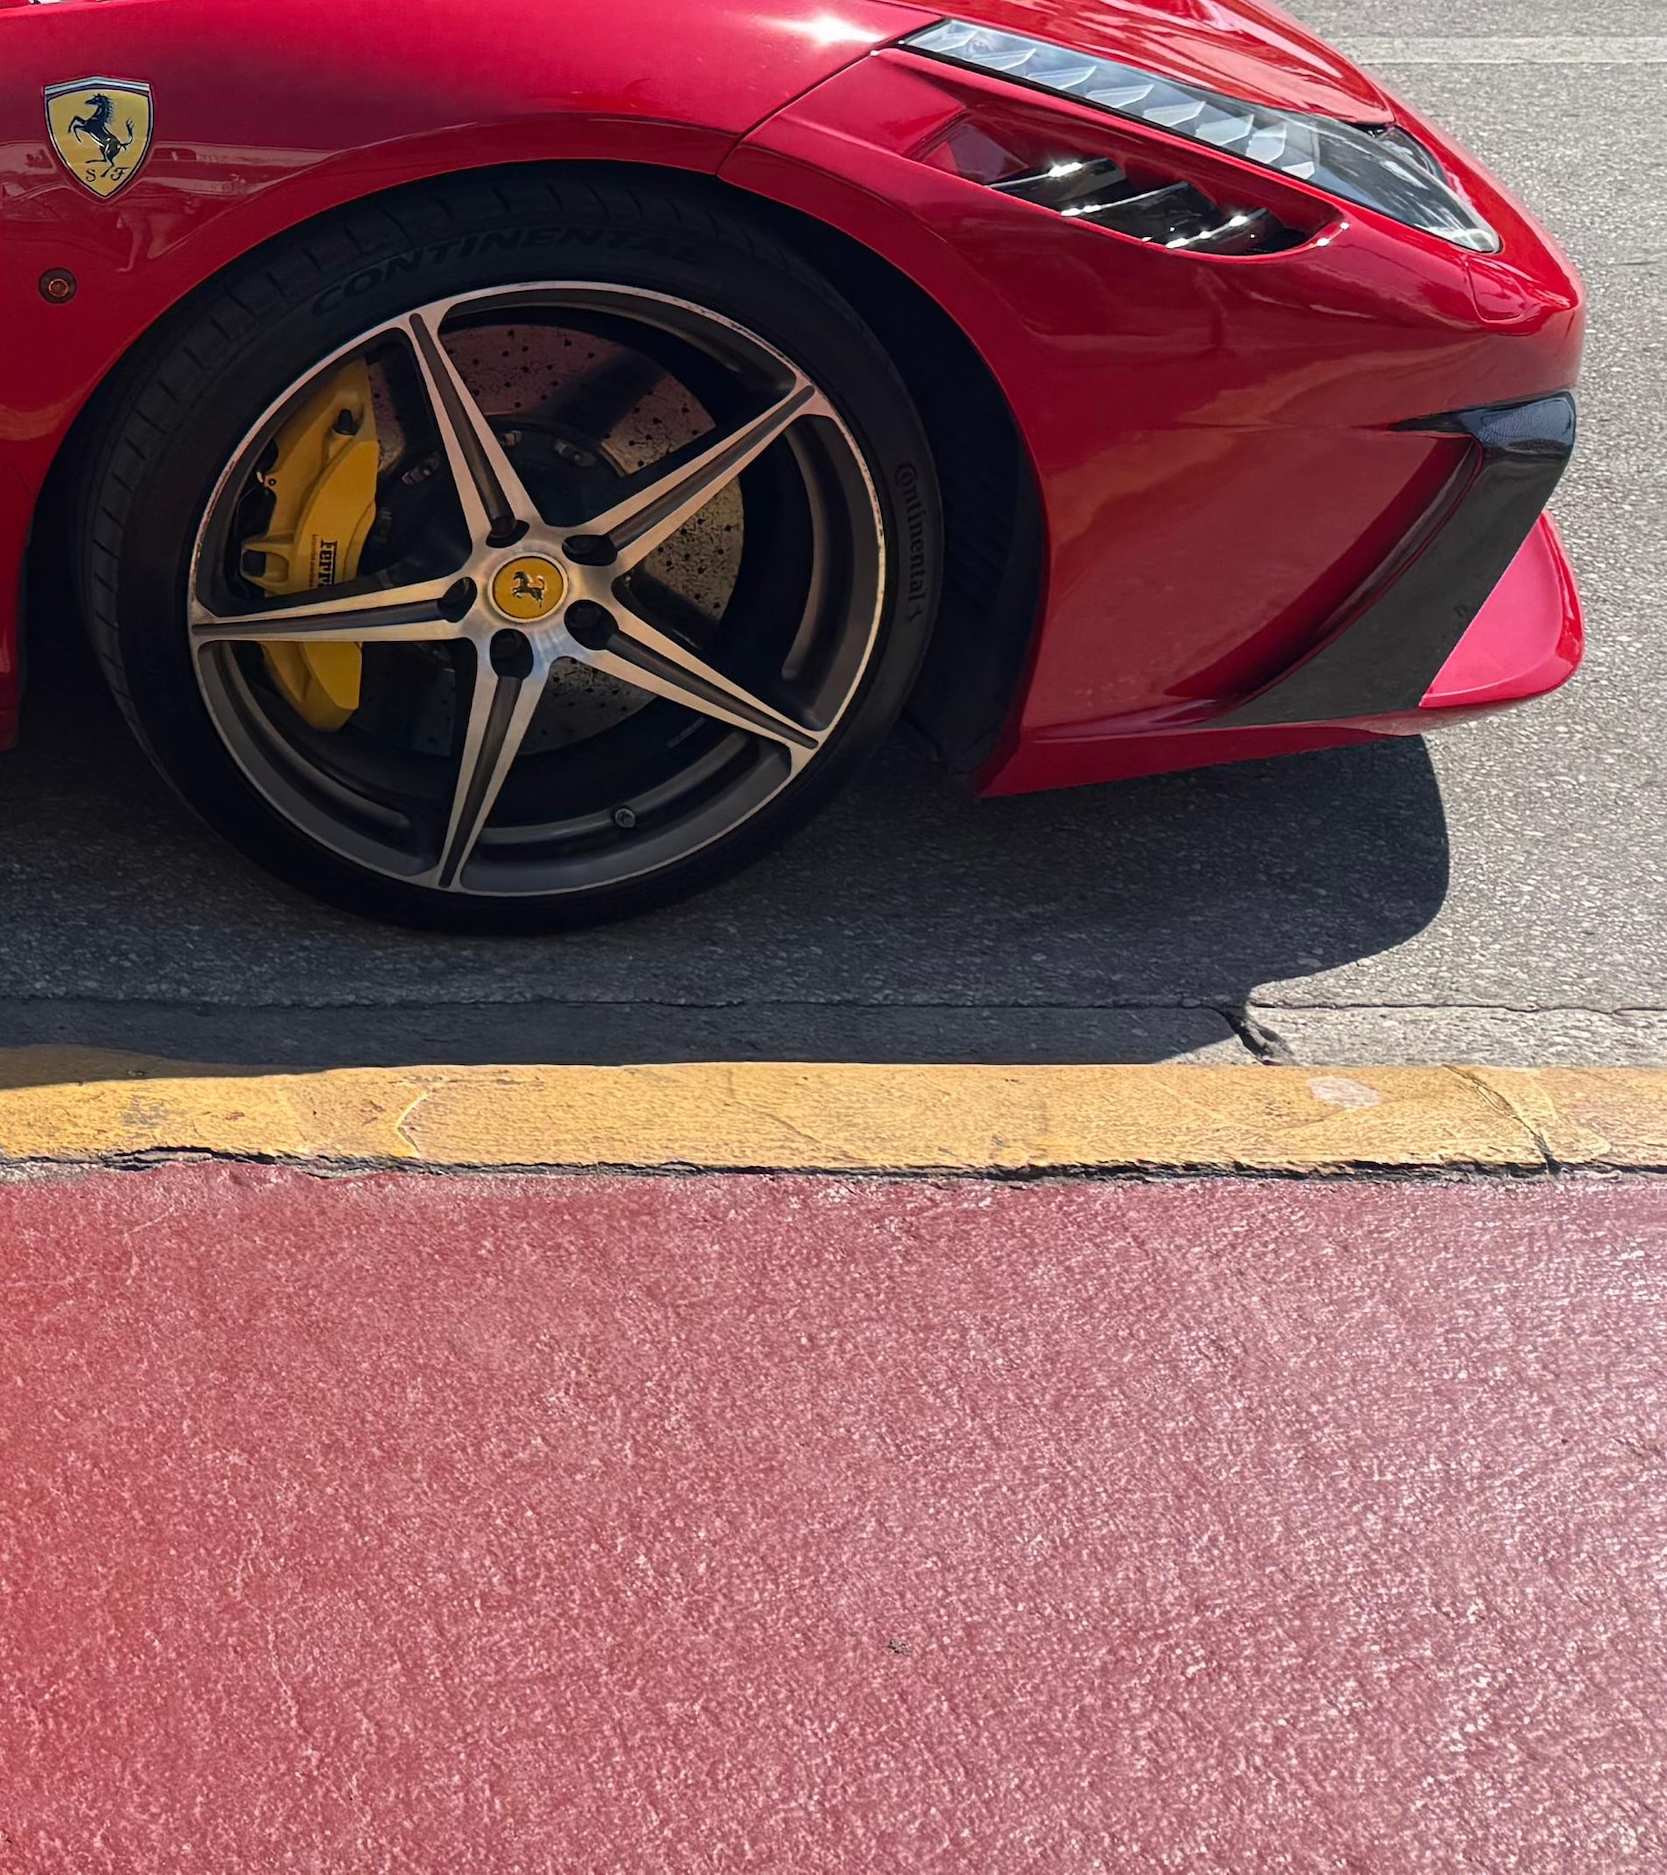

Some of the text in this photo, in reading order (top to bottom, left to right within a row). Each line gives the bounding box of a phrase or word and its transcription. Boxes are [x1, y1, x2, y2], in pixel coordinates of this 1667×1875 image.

[84, 165, 130, 183] S F
[311, 226, 701, 318] CONTINENTAL
[318, 540, 338, 586] Ferr
[895, 461, 927, 603] Continental
